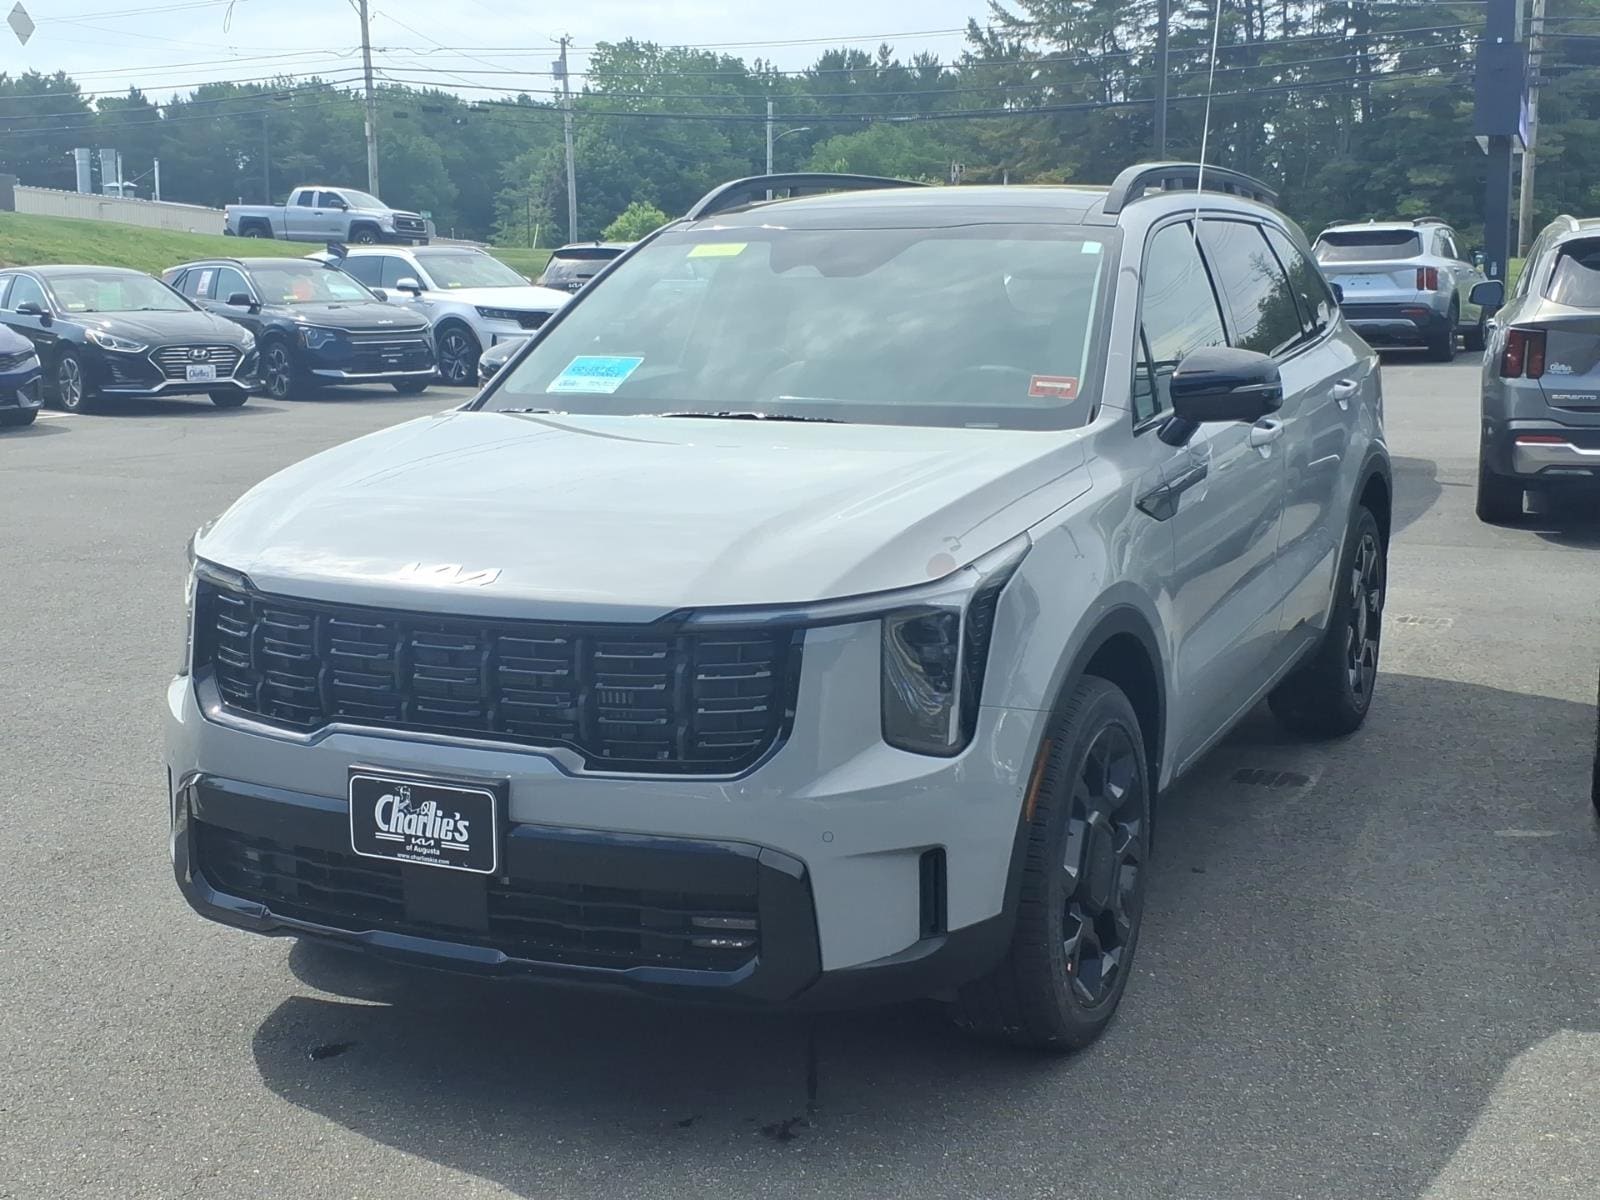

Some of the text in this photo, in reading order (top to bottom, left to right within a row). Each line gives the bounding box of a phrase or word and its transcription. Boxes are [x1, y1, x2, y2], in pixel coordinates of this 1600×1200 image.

[374, 794, 470, 842] Charlie's
[411, 837, 435, 846] KIA
[413, 845, 440, 856] Augusta
